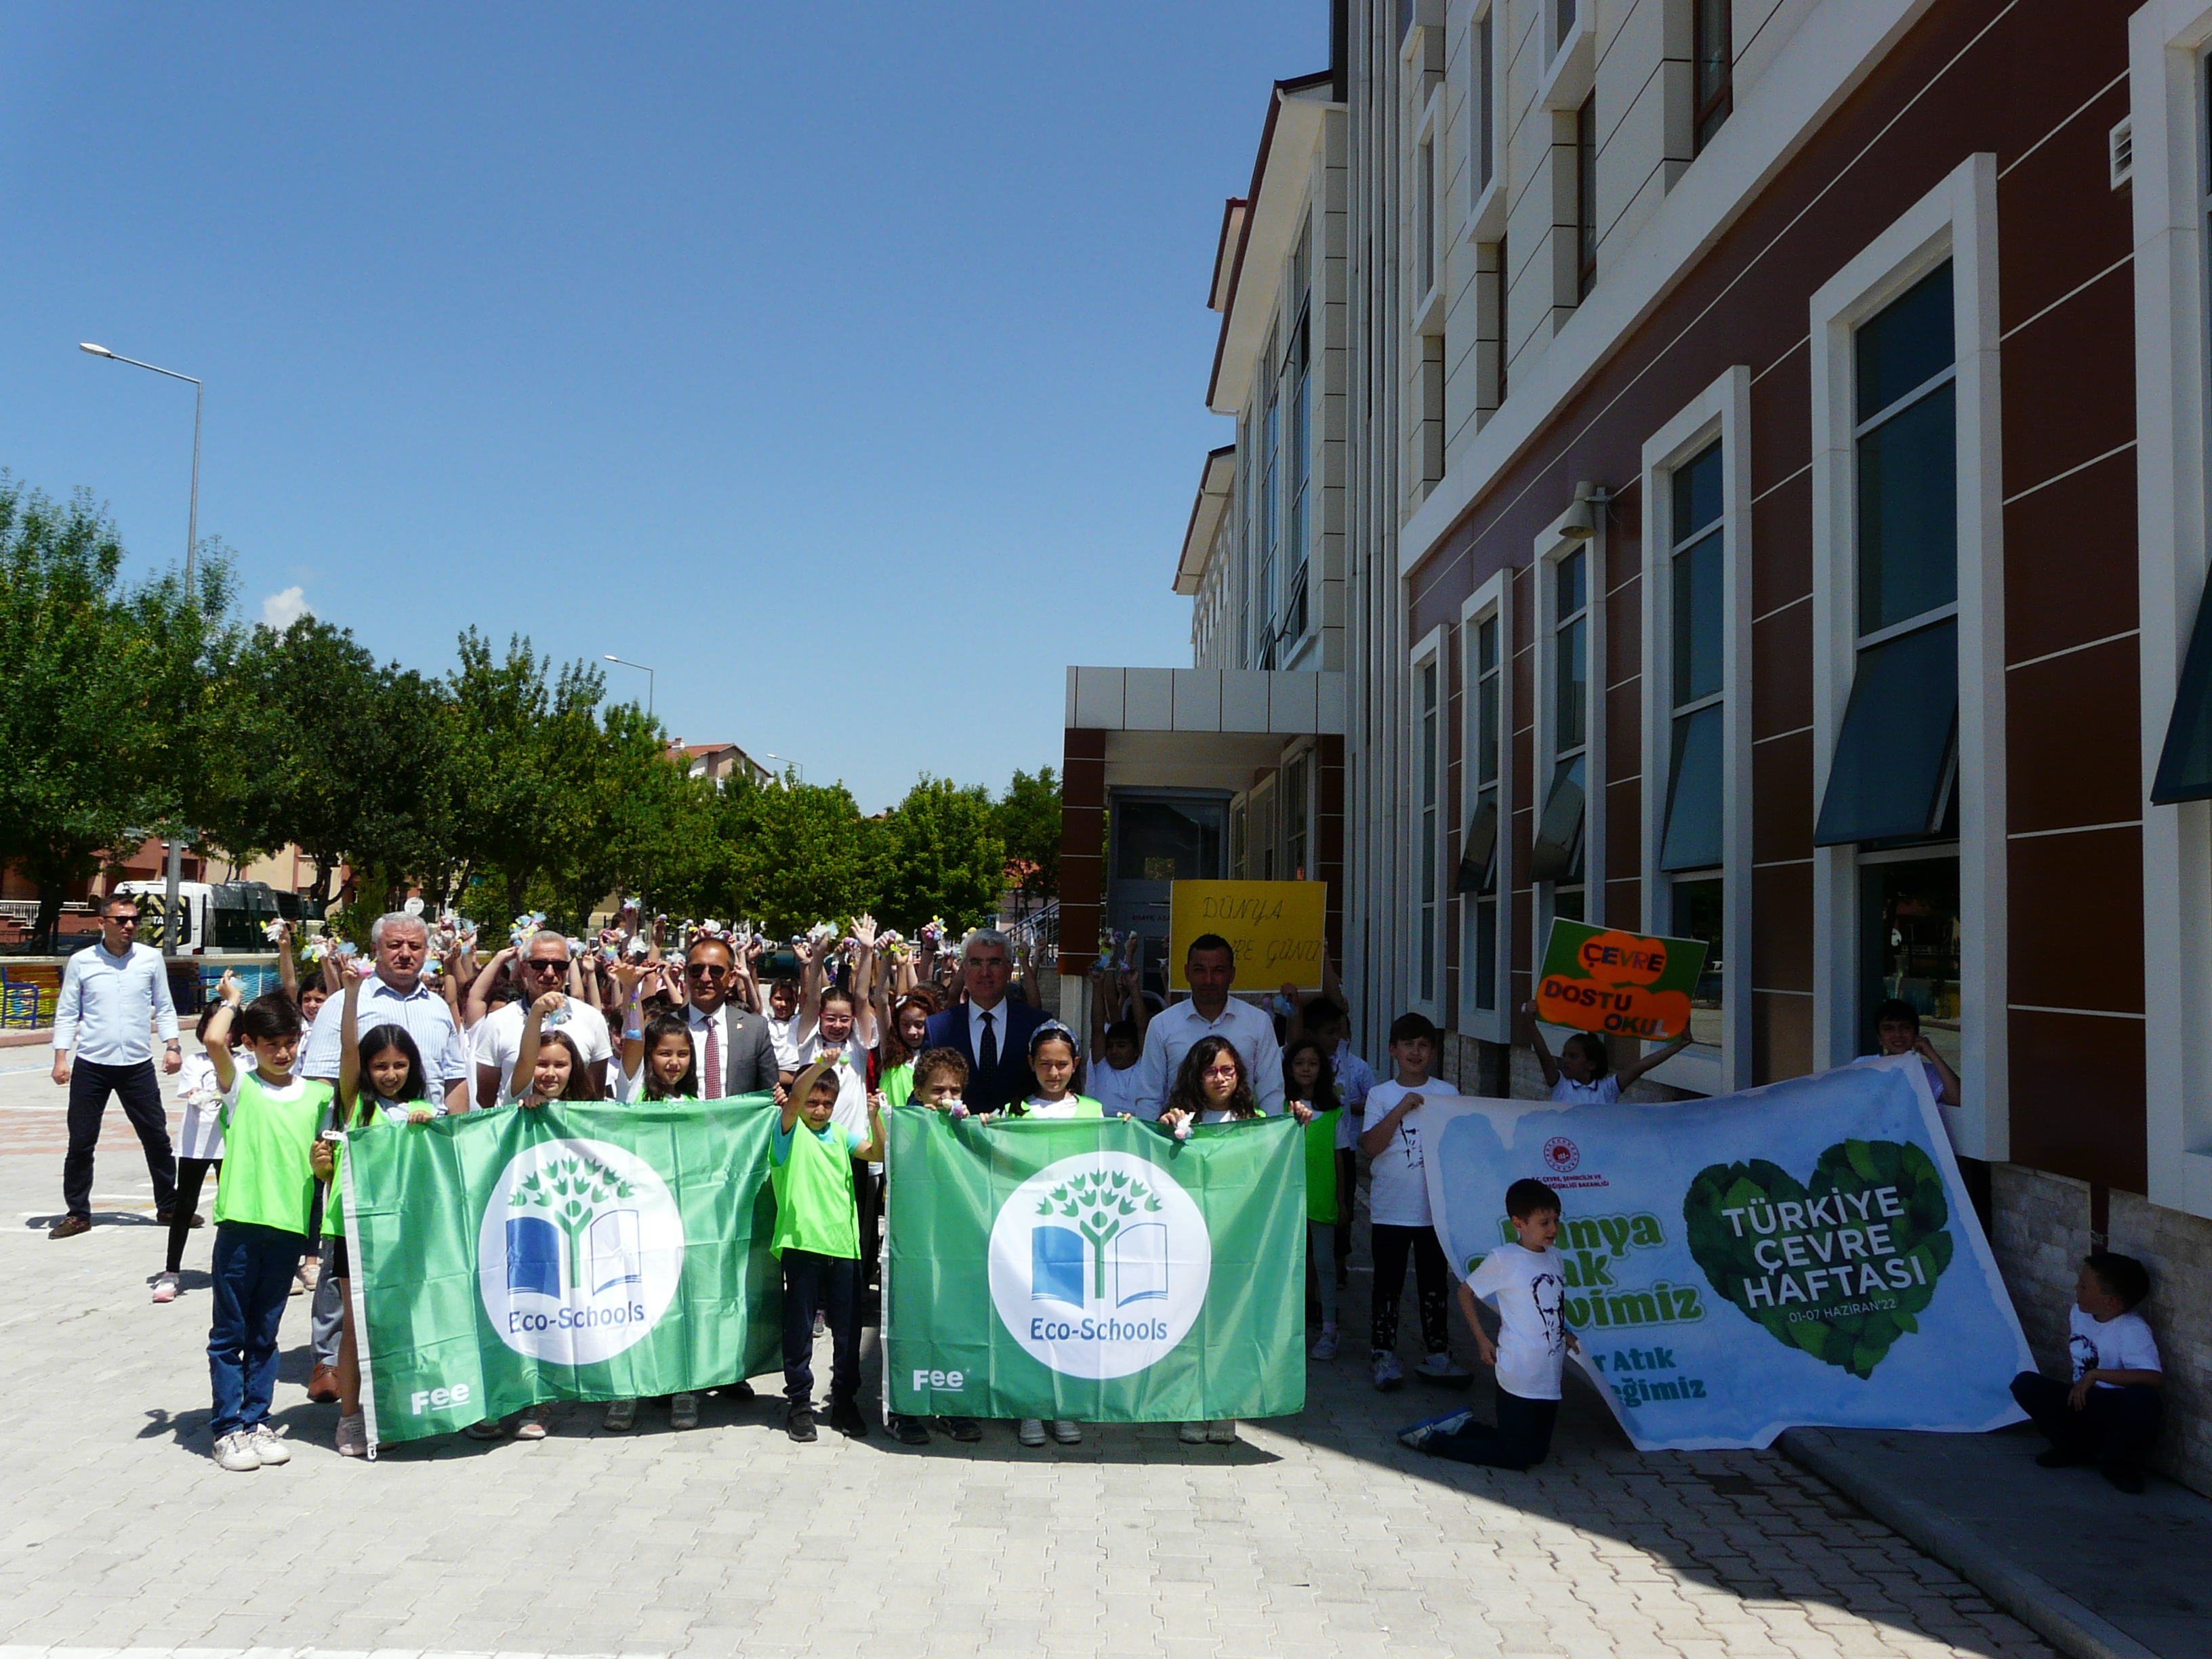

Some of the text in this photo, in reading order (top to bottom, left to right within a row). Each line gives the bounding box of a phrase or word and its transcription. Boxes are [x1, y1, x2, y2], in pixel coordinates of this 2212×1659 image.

[1203, 895, 1283, 926] DÜNYA
[1583, 943, 1664, 972] ÇEVRE
[1544, 980, 1632, 1011] DOSTU
[1604, 1014, 1668, 1038] OKUL
[1721, 1186, 1905, 1237] TÜRKİYE
[1754, 1224, 1896, 1275] ÇEVRE
[1743, 1255, 1927, 1309] HAFTASI
[510, 1300, 644, 1334] Eco-Schools
[1563, 1284, 1702, 1327] vimiz
[1788, 1309, 1820, 1323] 01-07
[1030, 1317, 1168, 1340] Eco-Schools
[1614, 1347, 1677, 1371] Atık
